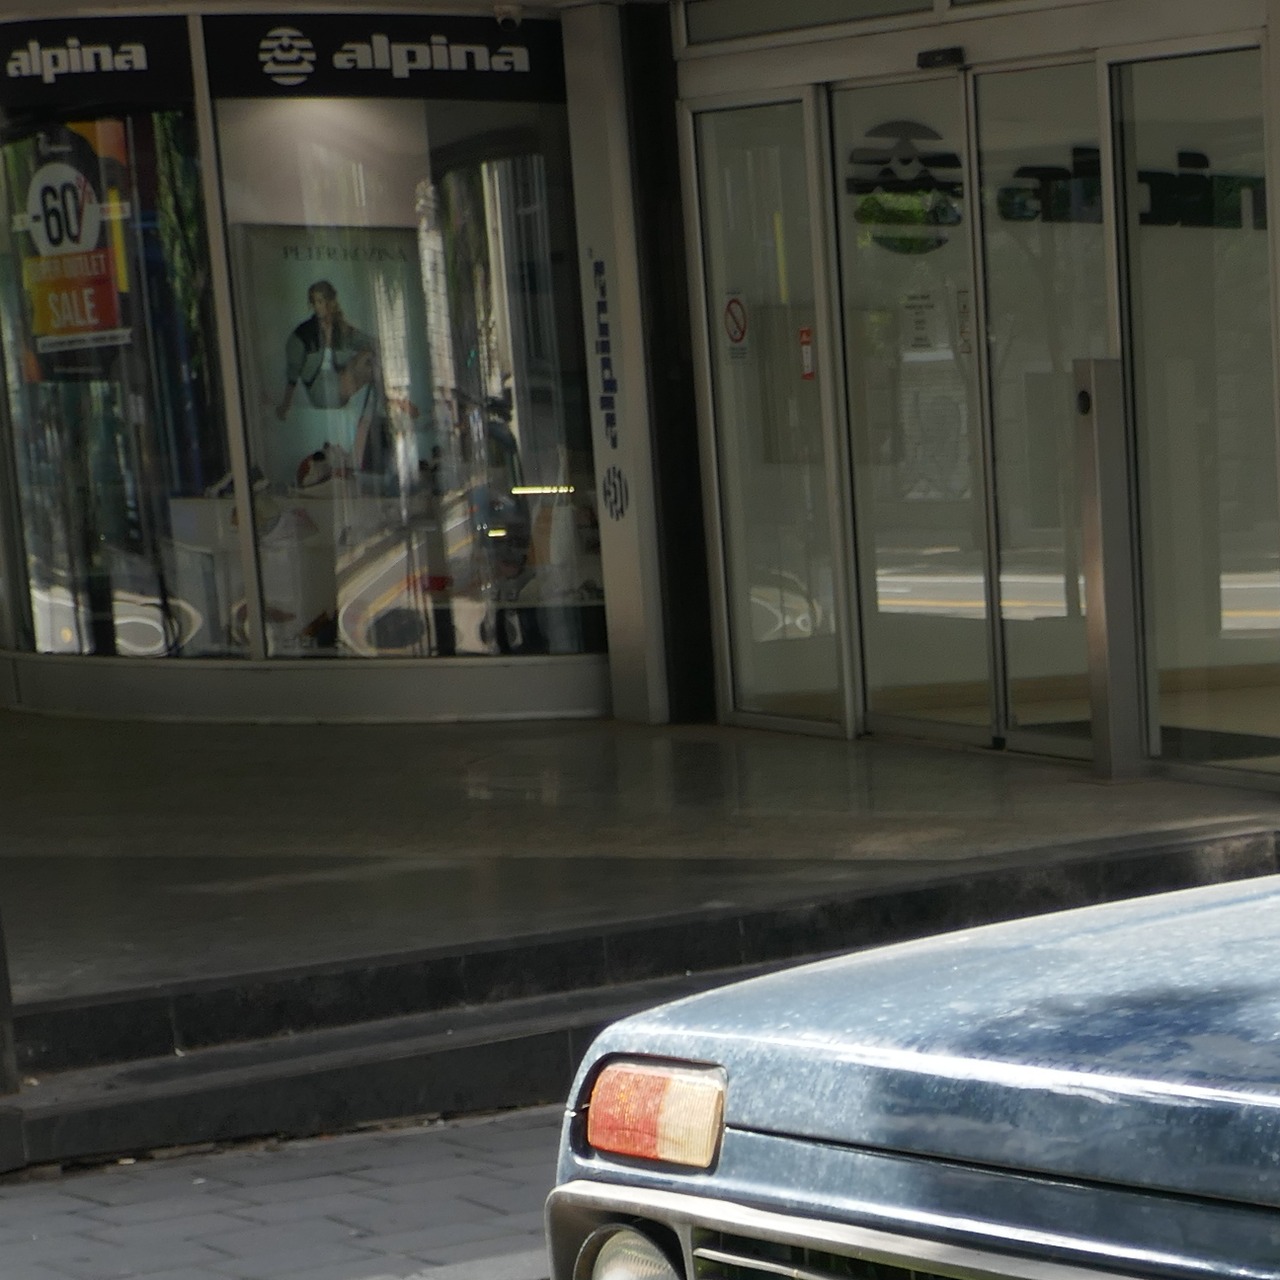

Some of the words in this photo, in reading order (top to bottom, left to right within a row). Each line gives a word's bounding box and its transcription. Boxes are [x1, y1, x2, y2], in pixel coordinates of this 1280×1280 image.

[6, 36, 148, 84] alpina
[332, 33, 530, 78] alpina
[64, 253, 106, 279] OUTLET
[48, 287, 100, 328] SALE
[593, 261, 618, 450] alpina
